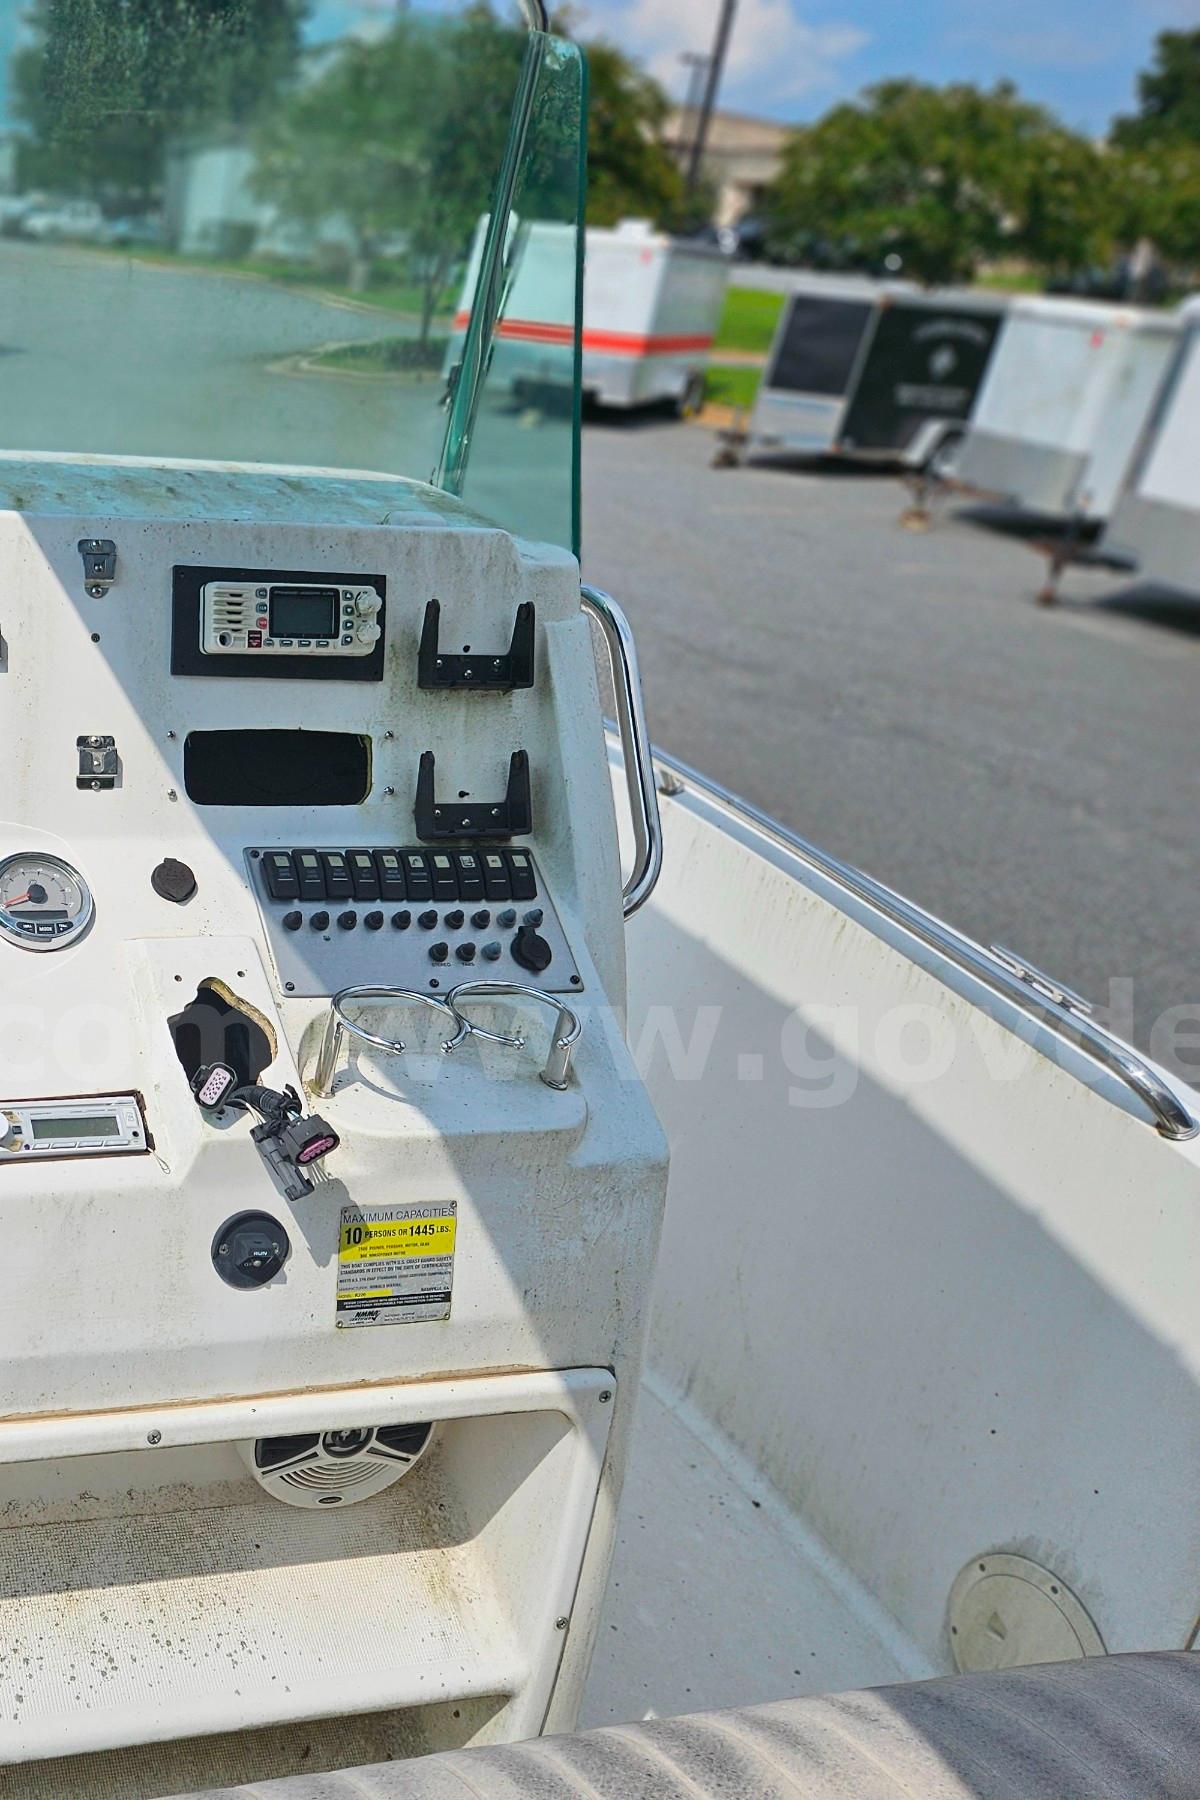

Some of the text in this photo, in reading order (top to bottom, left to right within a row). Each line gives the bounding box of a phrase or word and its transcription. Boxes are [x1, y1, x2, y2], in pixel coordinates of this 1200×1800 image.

[344, 1208, 454, 1224] MAXIMUM CAPACITIES
[345, 1228, 362, 1244] 10
[364, 1230, 396, 1238] PERSONS
[409, 1224, 435, 1236] 1445
